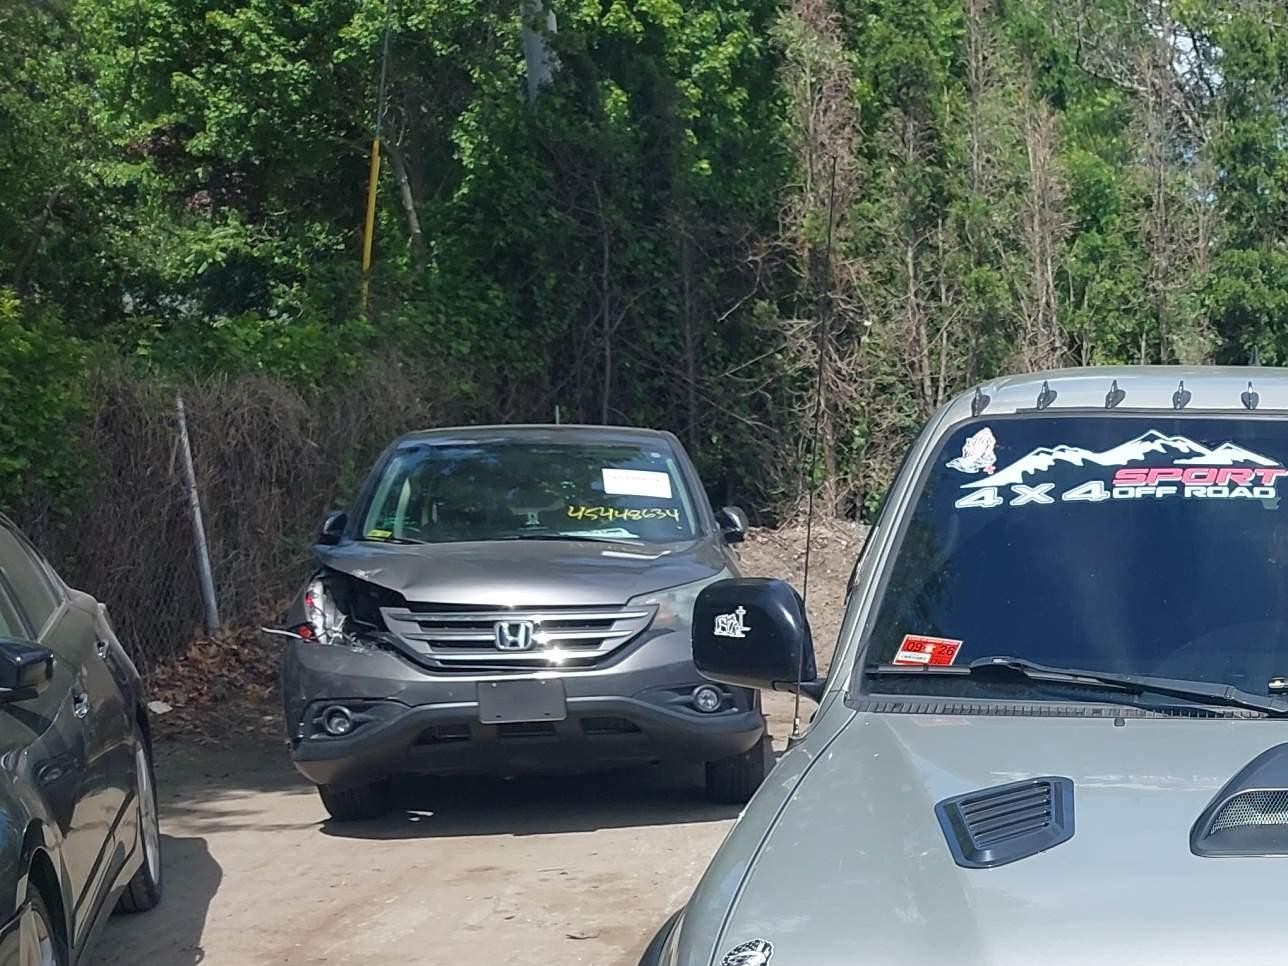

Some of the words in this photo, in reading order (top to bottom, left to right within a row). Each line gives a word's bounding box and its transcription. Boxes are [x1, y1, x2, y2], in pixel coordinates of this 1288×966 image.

[1112, 468, 1288, 486] SPORT
[1112, 486, 1178, 498] OFF
[1184, 486, 1276, 498] ROAD
[567, 505, 681, 522] 45448634
[937, 645, 956, 656] 26
